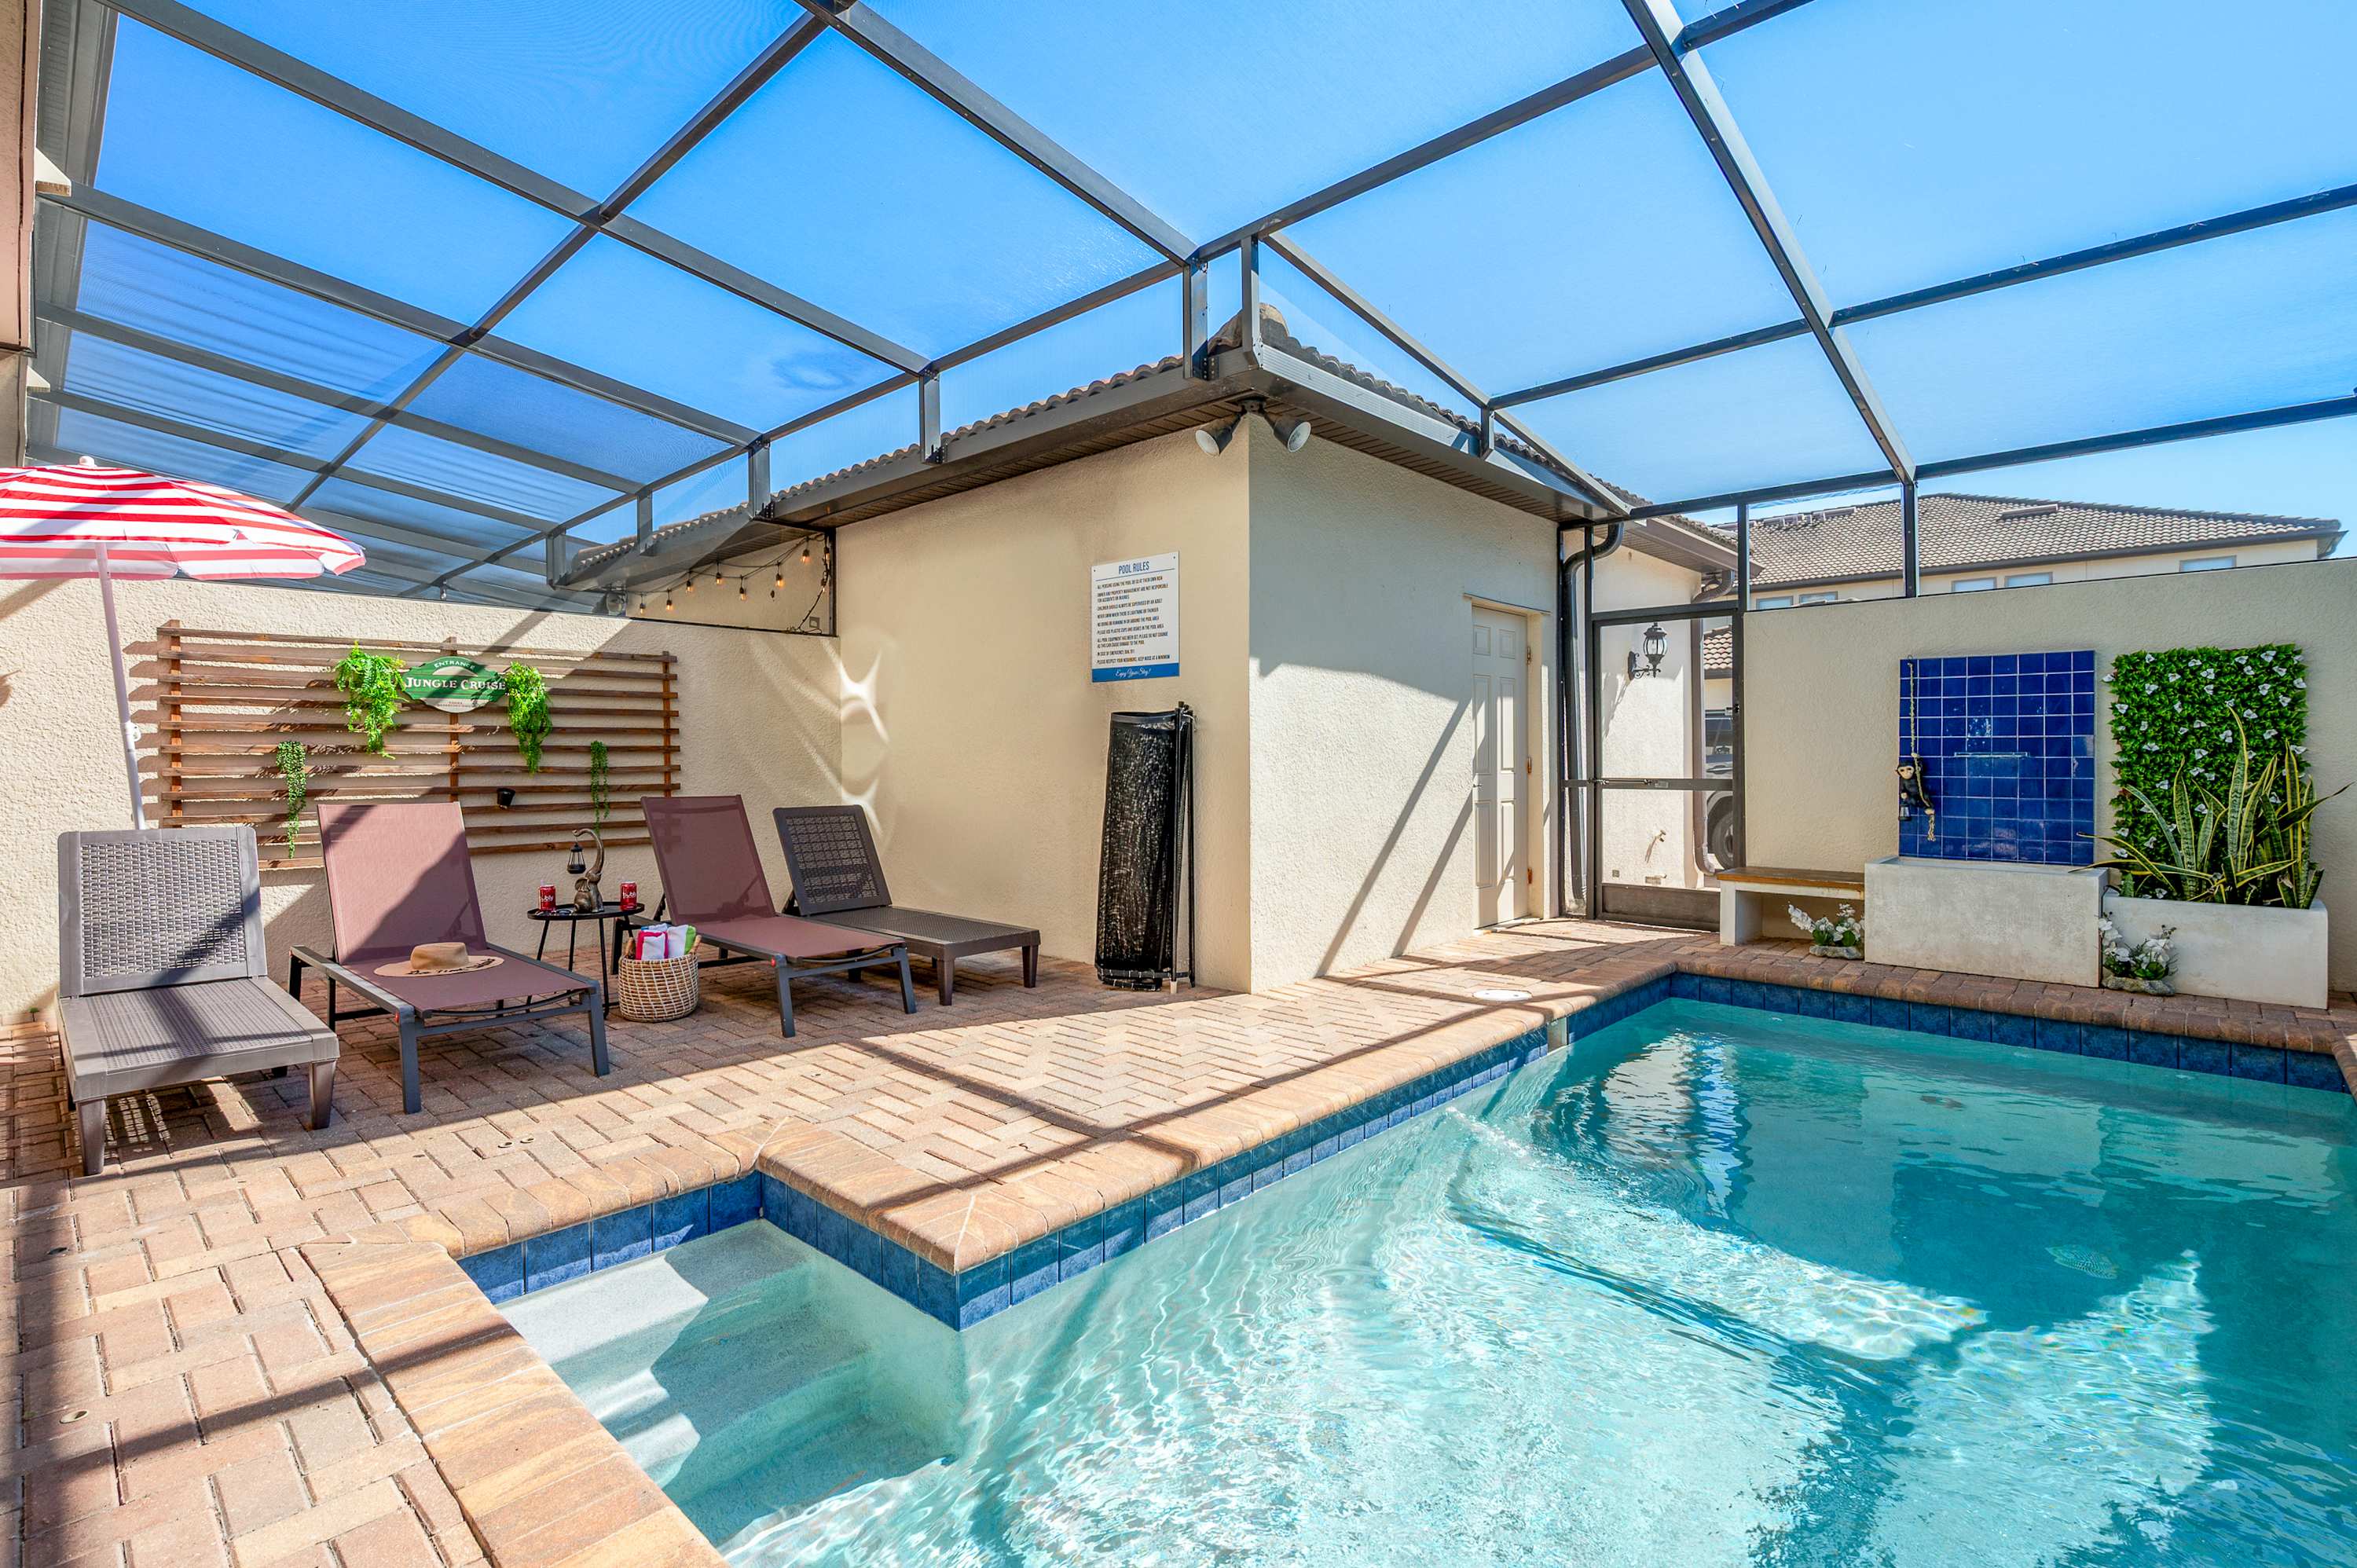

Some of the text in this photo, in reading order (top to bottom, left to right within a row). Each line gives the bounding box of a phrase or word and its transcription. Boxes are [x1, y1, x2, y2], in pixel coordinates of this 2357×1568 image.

[1119, 561, 1149, 575] POOL RULES
[434, 660, 475, 669] ENTRANCE
[405, 677, 506, 690] JUNGLE CRUISE
